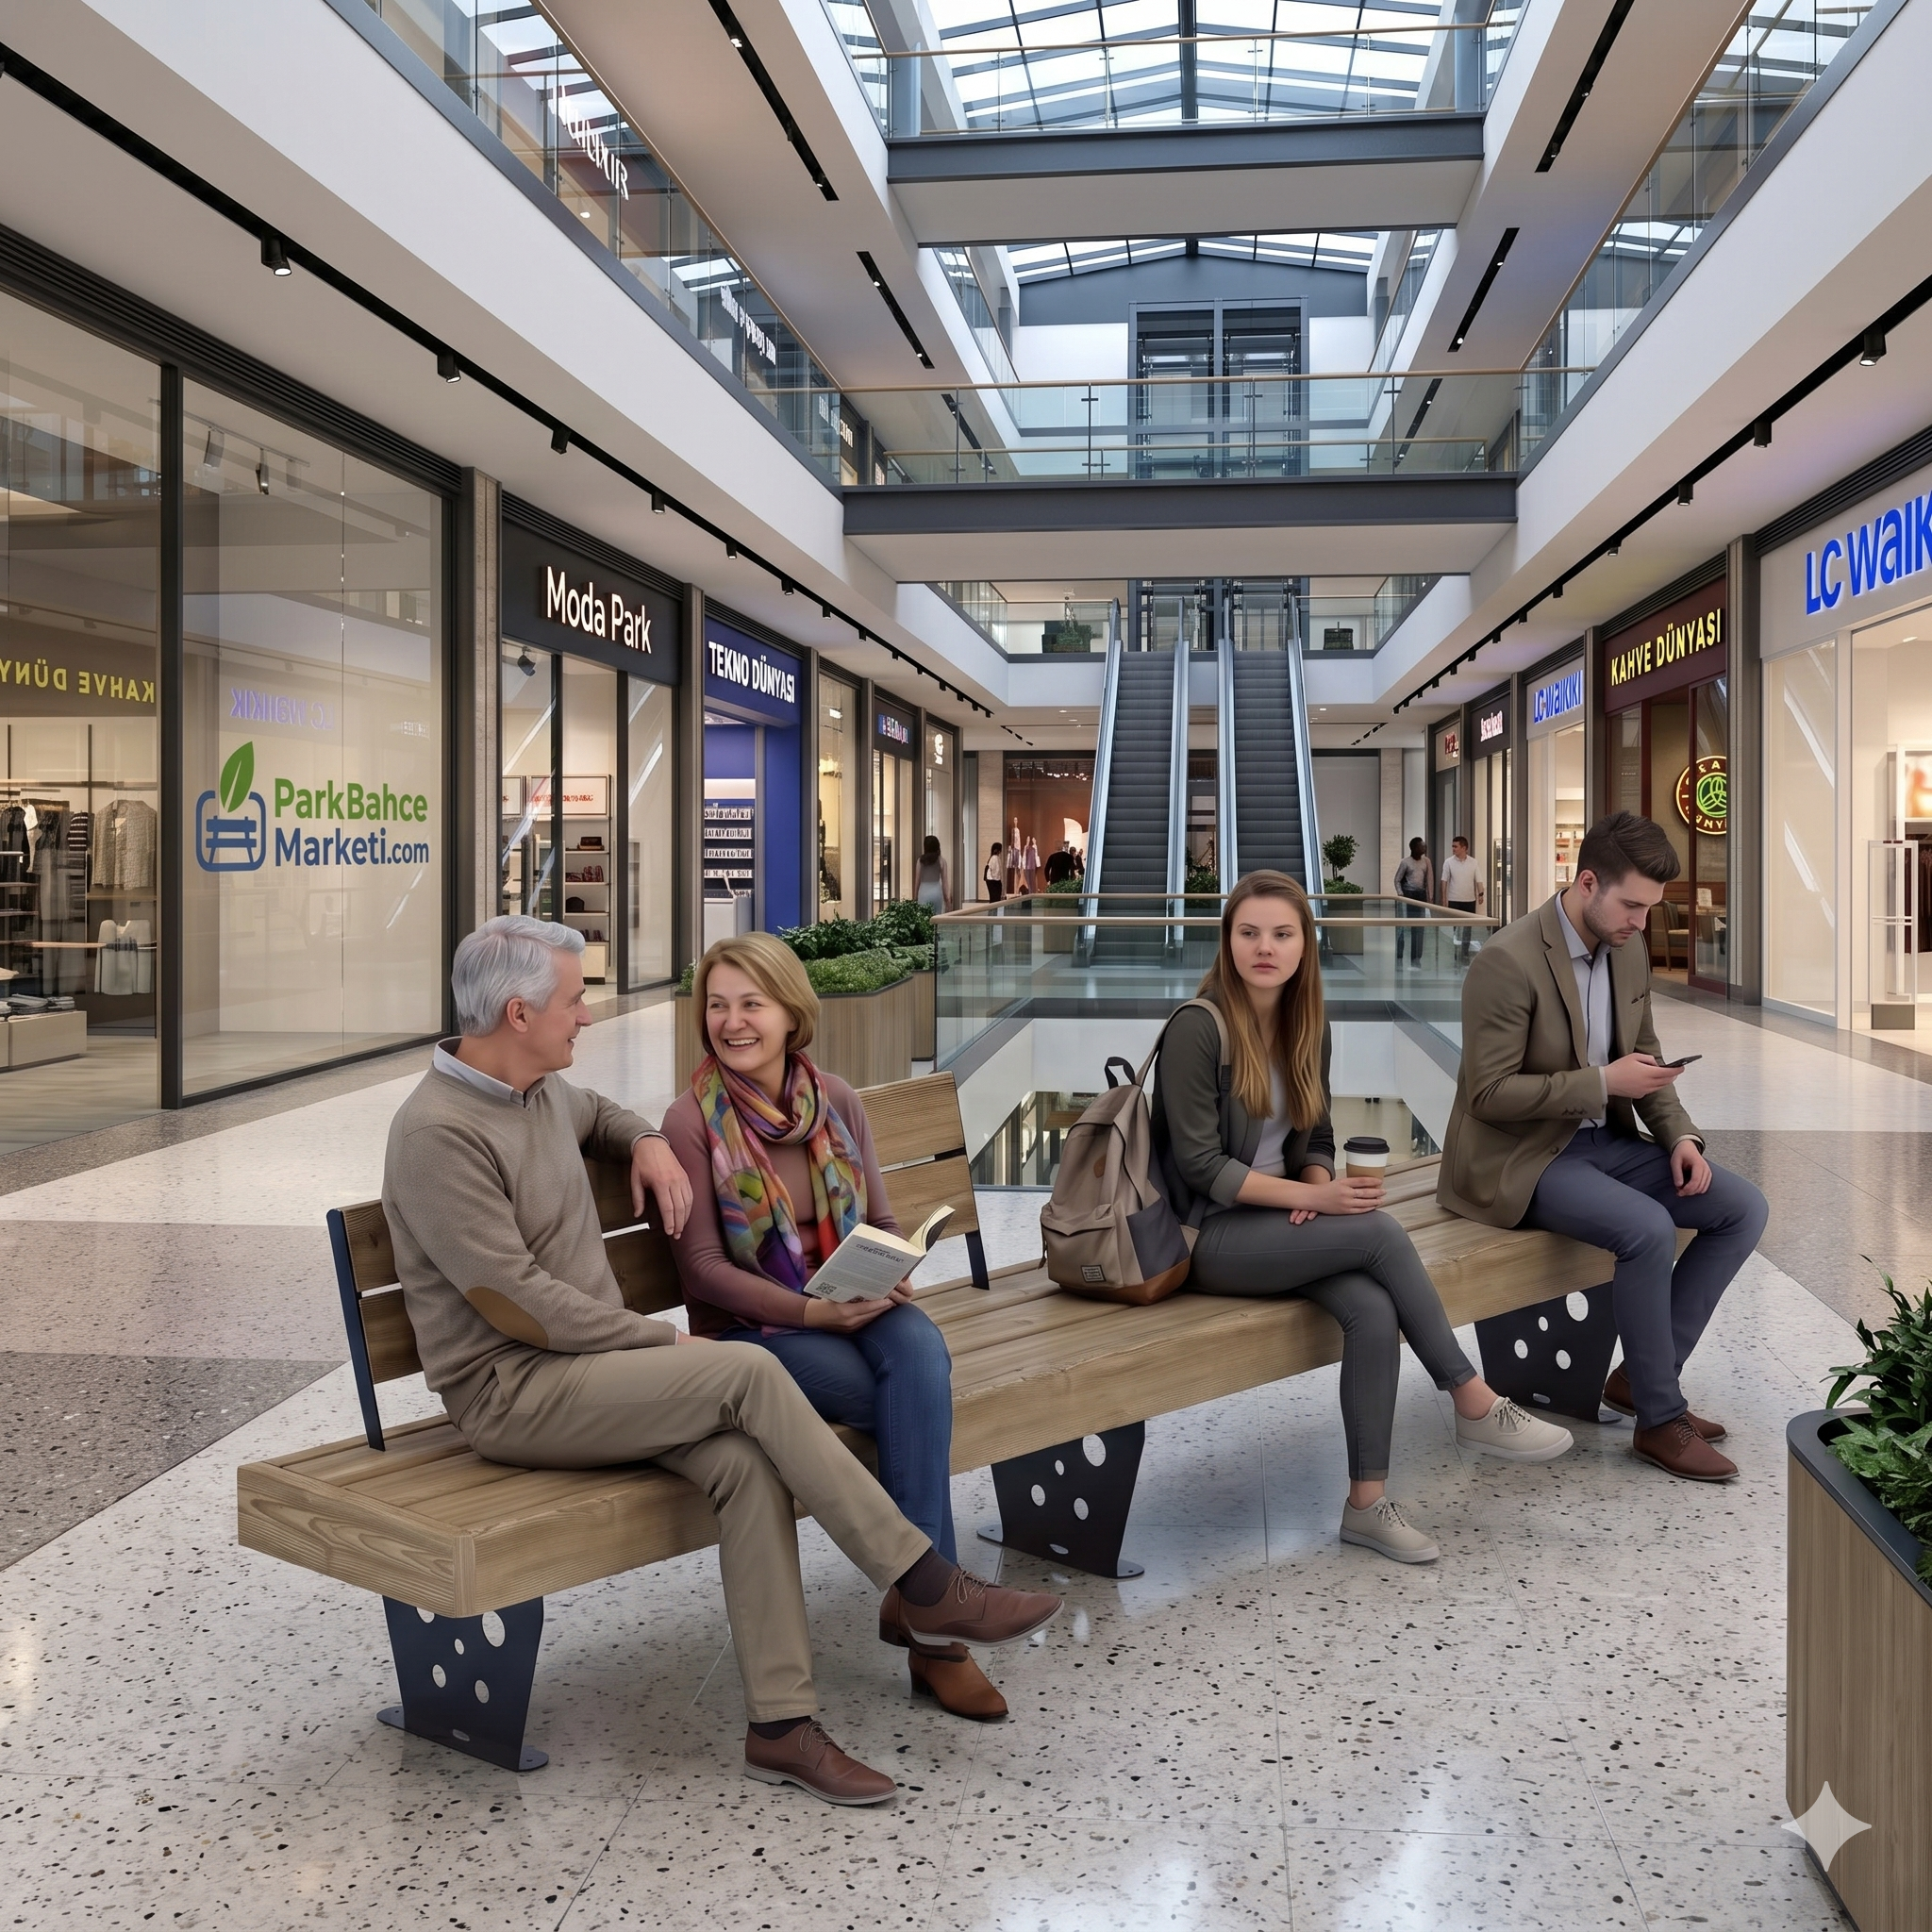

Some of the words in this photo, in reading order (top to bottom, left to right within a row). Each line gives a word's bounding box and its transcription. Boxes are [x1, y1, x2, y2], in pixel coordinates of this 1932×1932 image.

[546, 565, 606, 638] Moda
[611, 592, 652, 654] Park
[1806, 539, 1842, 615] LC
[708, 641, 750, 688] TEKNO
[752, 655, 795, 704] DÜNYASI
[1611, 641, 1652, 687] KAHVE
[1656, 608, 1721, 668] DÜNYASI
[275, 777, 428, 823] ParkBahce
[275, 826, 429, 867] Marketi.com
